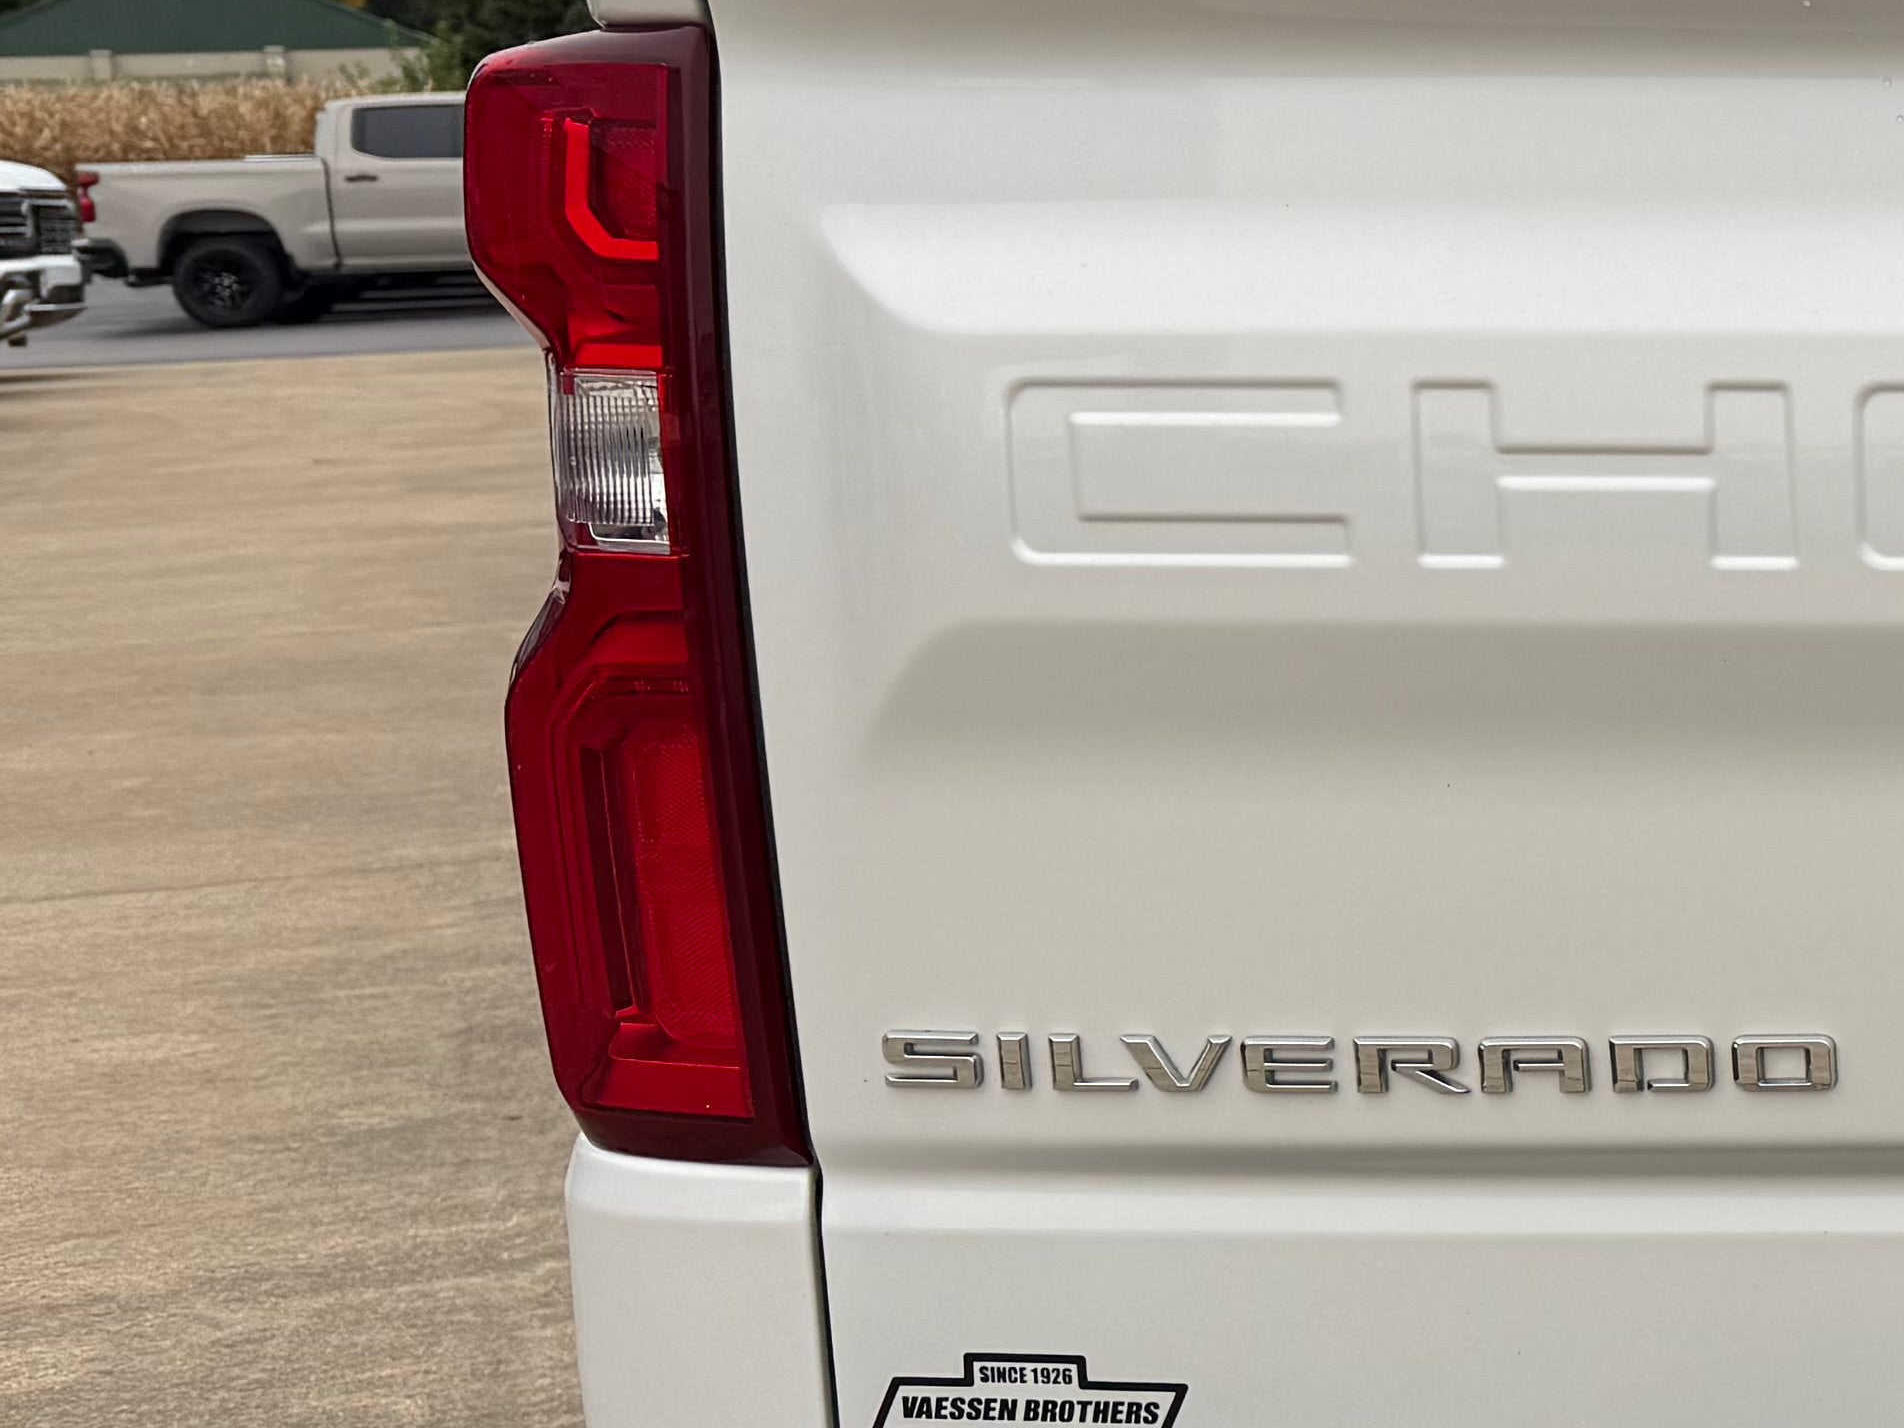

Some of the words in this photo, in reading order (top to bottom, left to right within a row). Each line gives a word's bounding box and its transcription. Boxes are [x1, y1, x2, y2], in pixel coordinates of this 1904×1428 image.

[881, 1029, 1839, 1095] SILVERADO
[979, 1365, 1028, 1384] SINCE
[1030, 1367, 1073, 1386] 1926
[901, 1395, 1018, 1422] VAESSEN
[1023, 1399, 1160, 1425] BROTHERS
